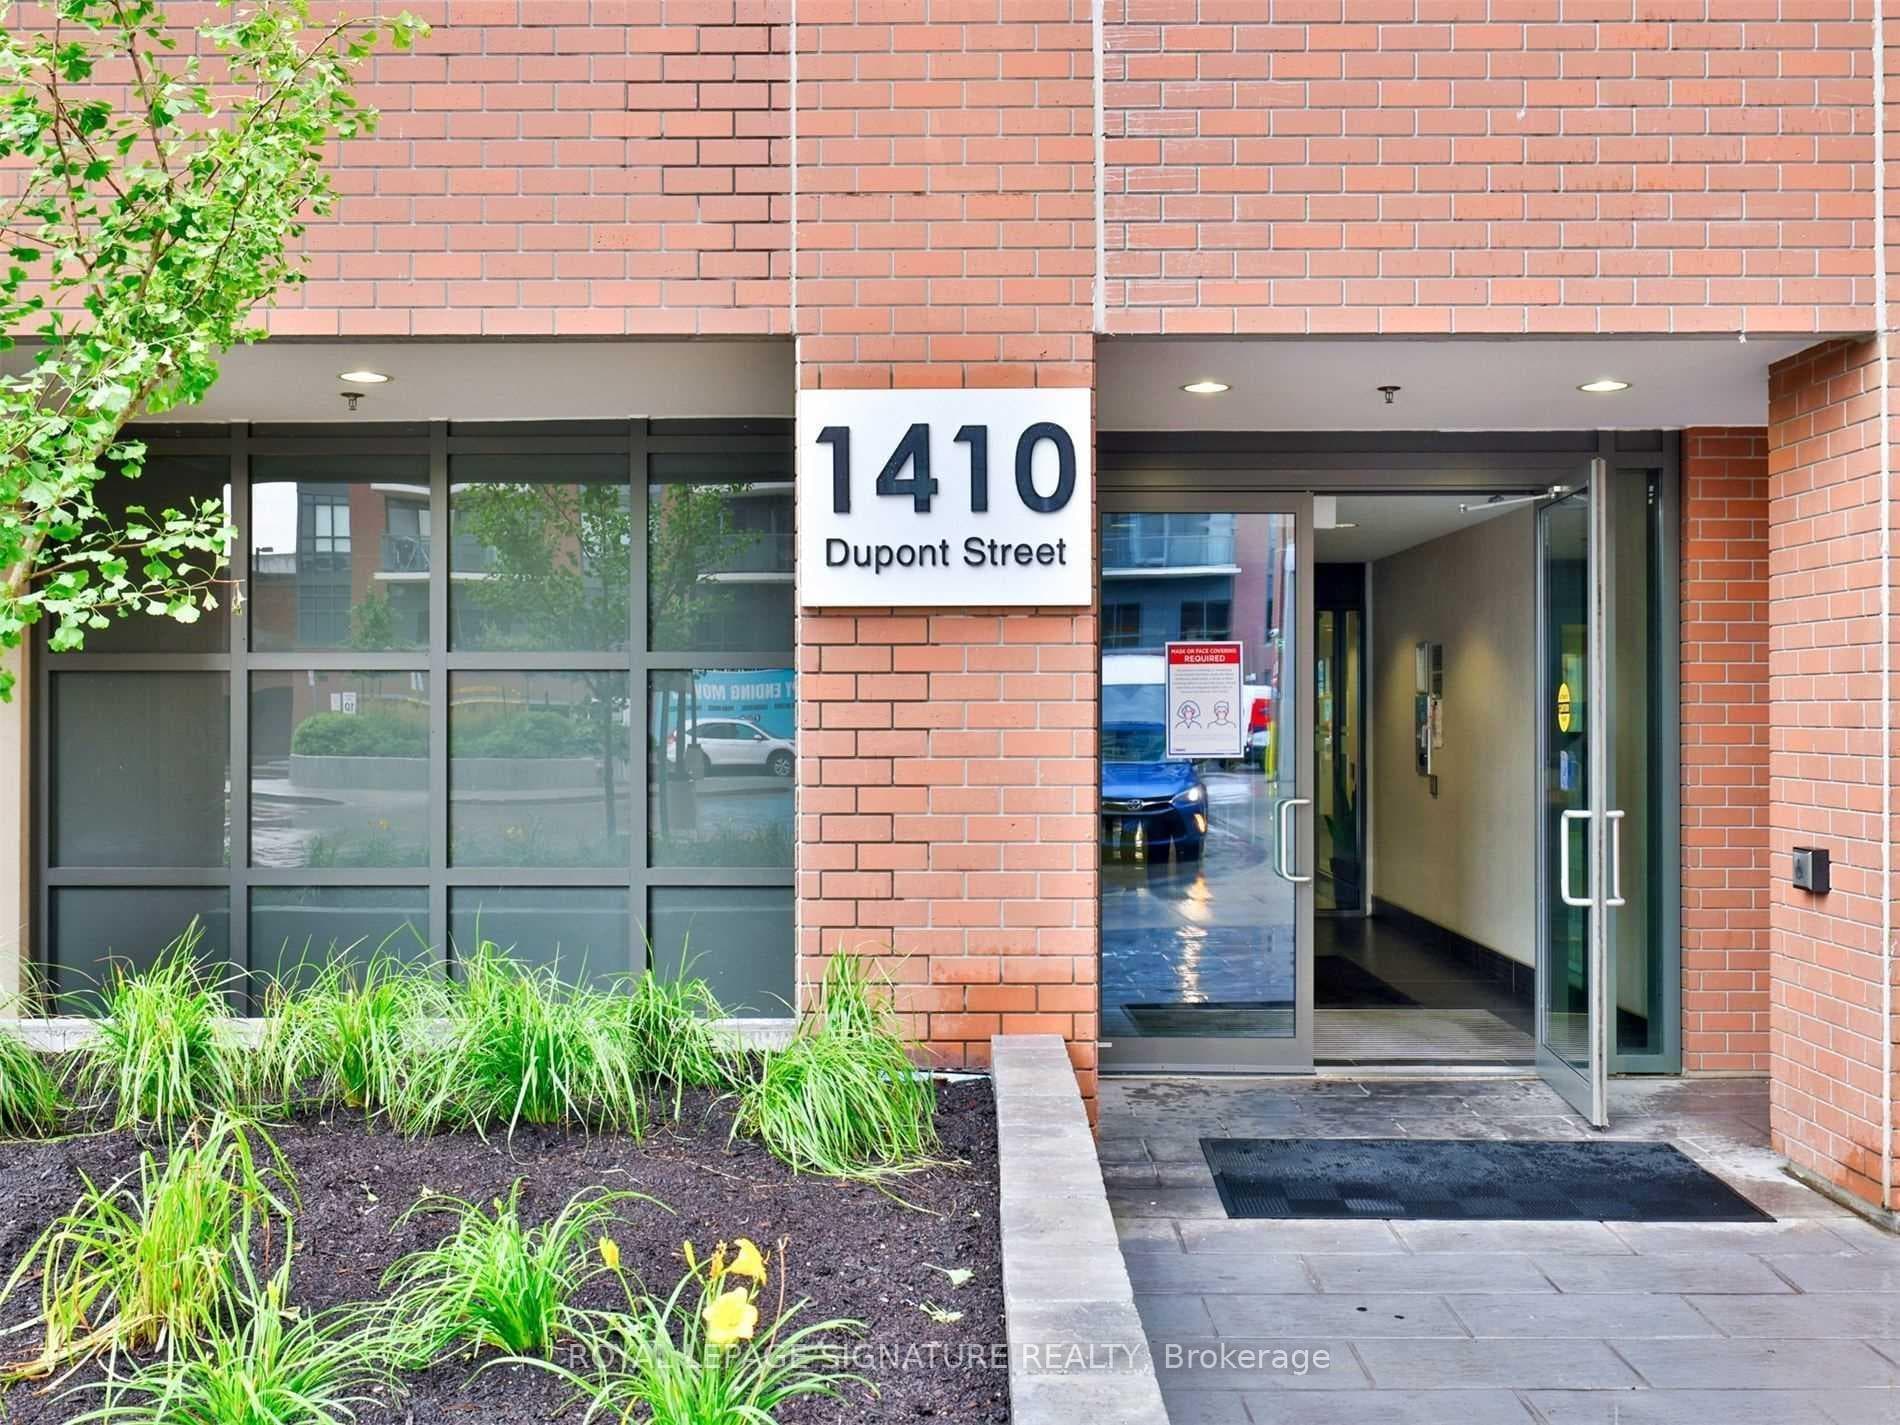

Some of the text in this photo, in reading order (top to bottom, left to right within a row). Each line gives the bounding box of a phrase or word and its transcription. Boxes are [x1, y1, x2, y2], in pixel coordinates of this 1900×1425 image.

[815, 421, 1077, 514] 1410
[825, 536, 1067, 575] Dupont Street
